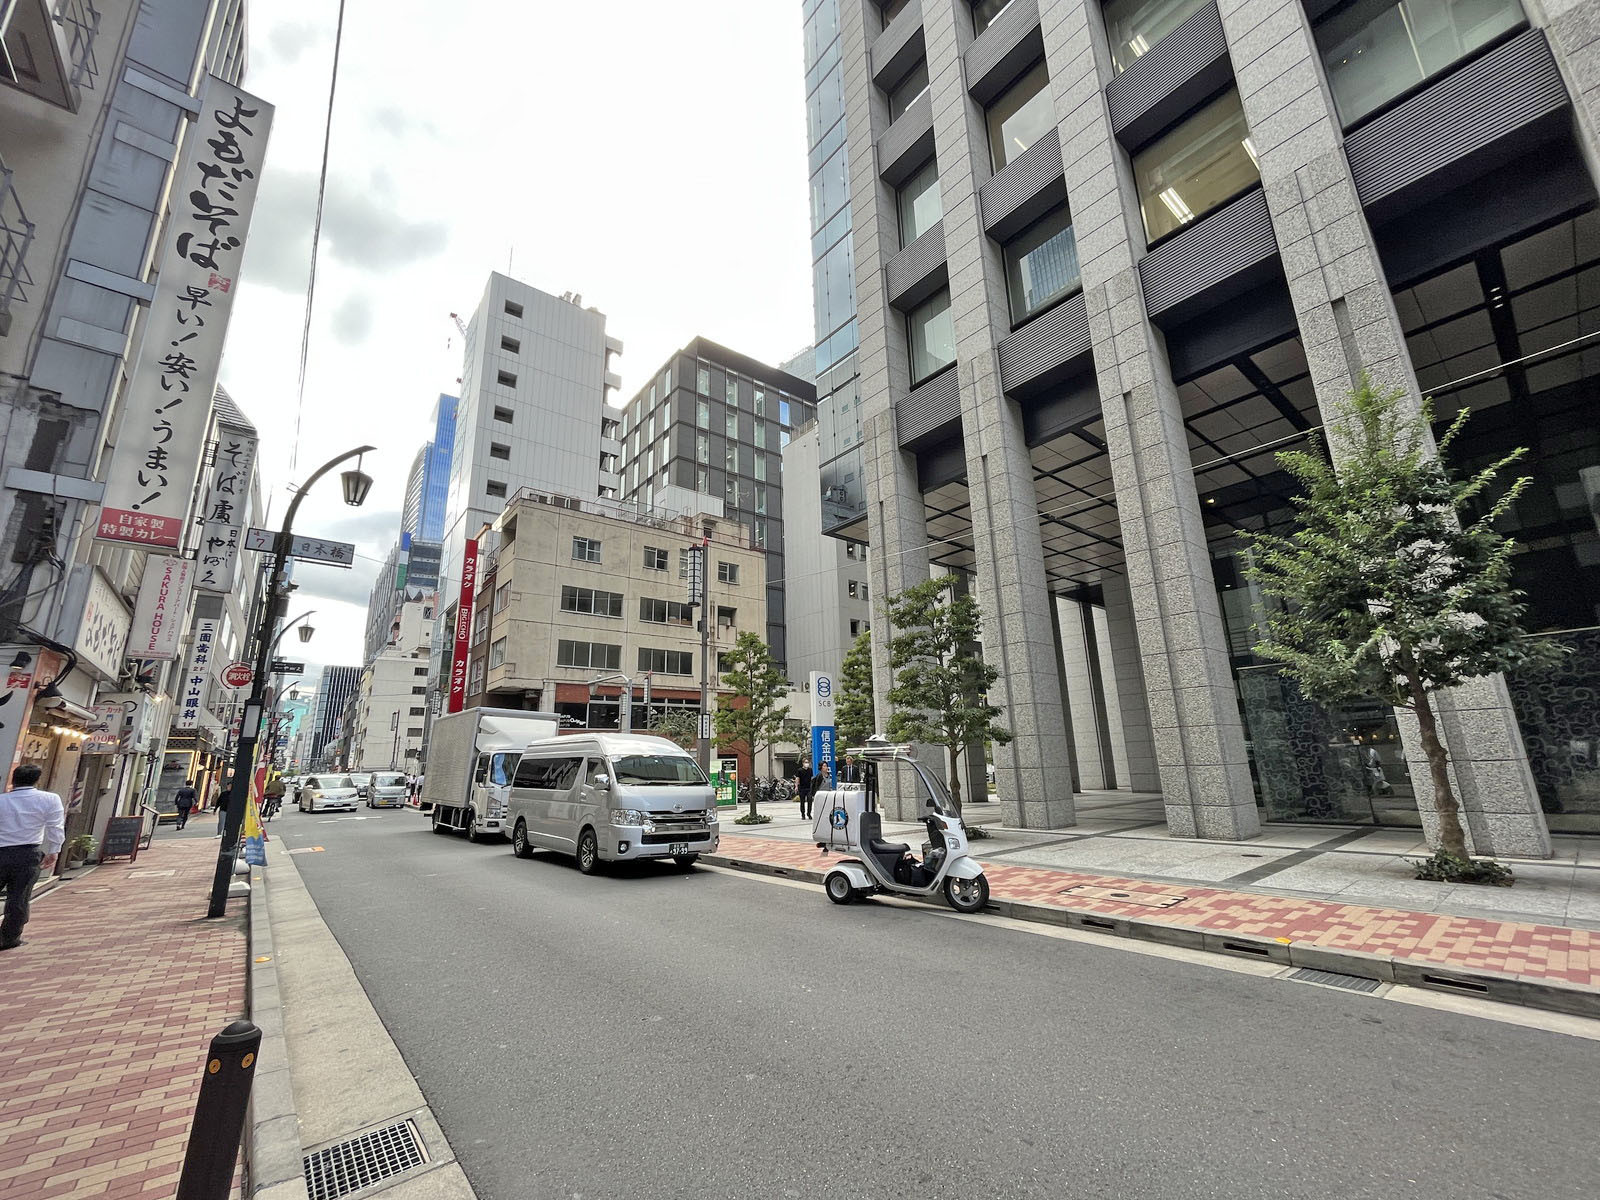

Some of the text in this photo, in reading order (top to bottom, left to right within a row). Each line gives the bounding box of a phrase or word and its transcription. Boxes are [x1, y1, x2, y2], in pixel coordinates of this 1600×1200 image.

[176, 96, 259, 271] よもだそば
[102, 523, 178, 541] 特製カレー
[119, 512, 166, 531] 自家製
[463, 557, 475, 588] カラオケ
[148, 567, 172, 650] SAKURA HOUSE
[461, 608, 469, 621] BIG
[453, 660, 464, 693] カラオケ
[183, 676, 203, 719] 中山眼科
